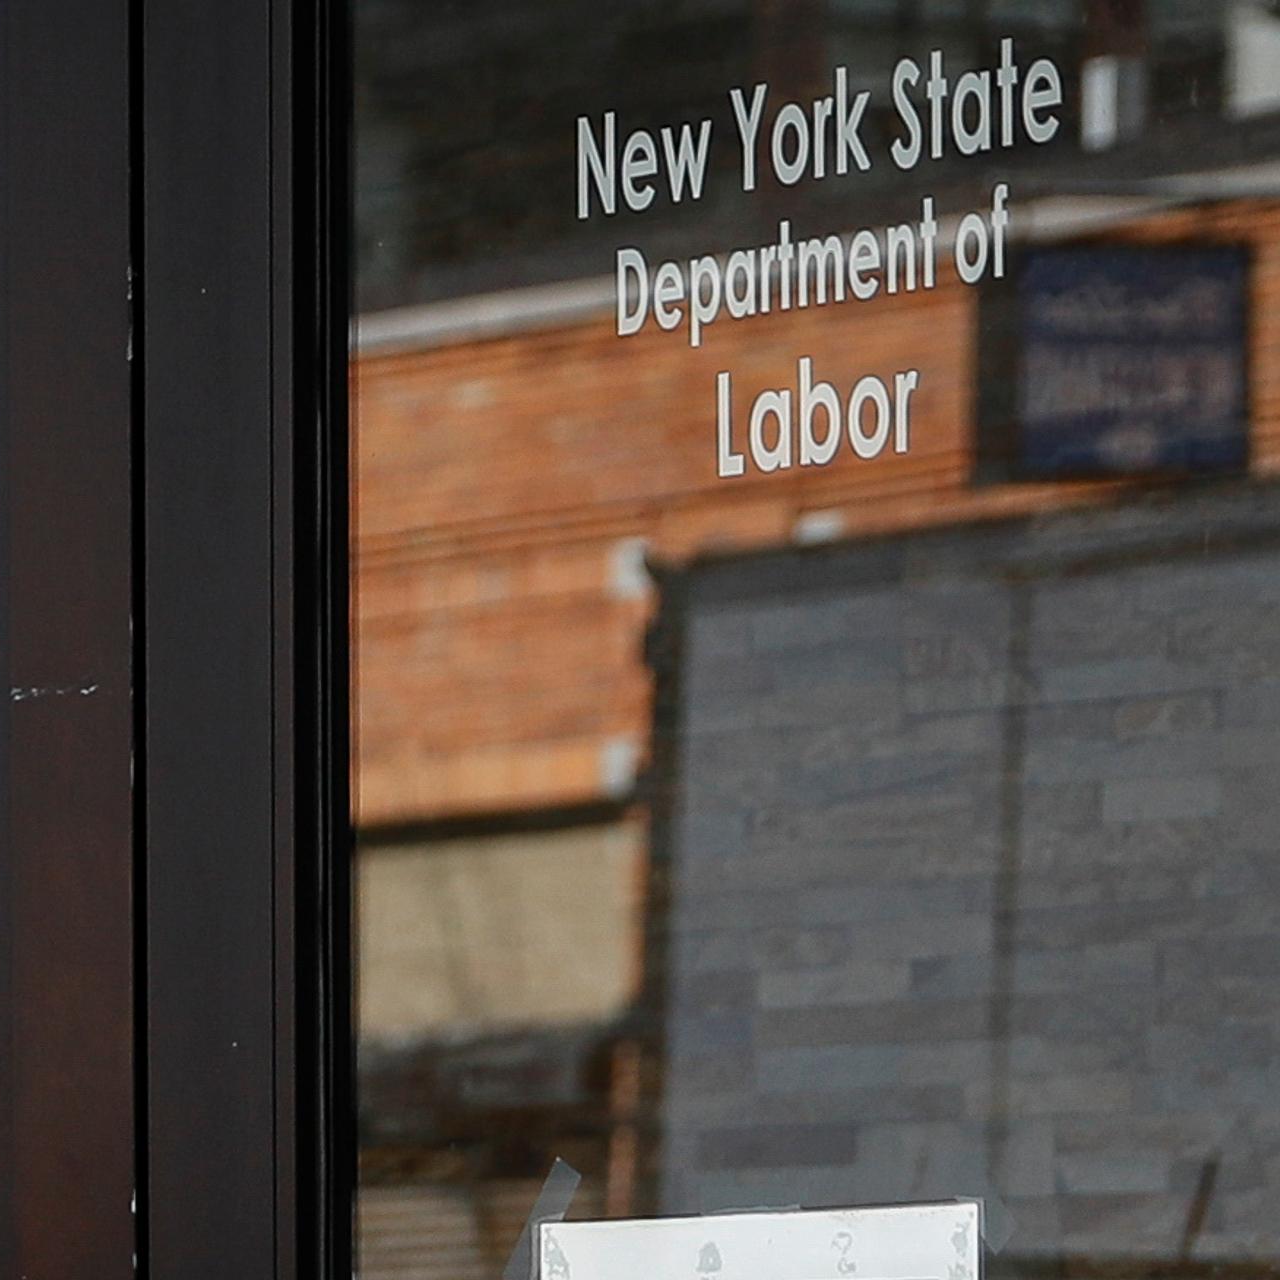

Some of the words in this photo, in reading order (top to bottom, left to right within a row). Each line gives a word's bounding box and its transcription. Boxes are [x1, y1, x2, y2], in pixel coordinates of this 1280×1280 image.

[578, 111, 711, 219] New
[731, 67, 870, 191] York
[891, 38, 1062, 170] State
[617, 197, 936, 346] Department
[956, 184, 1009, 283] of
[717, 357, 918, 476] Labor
